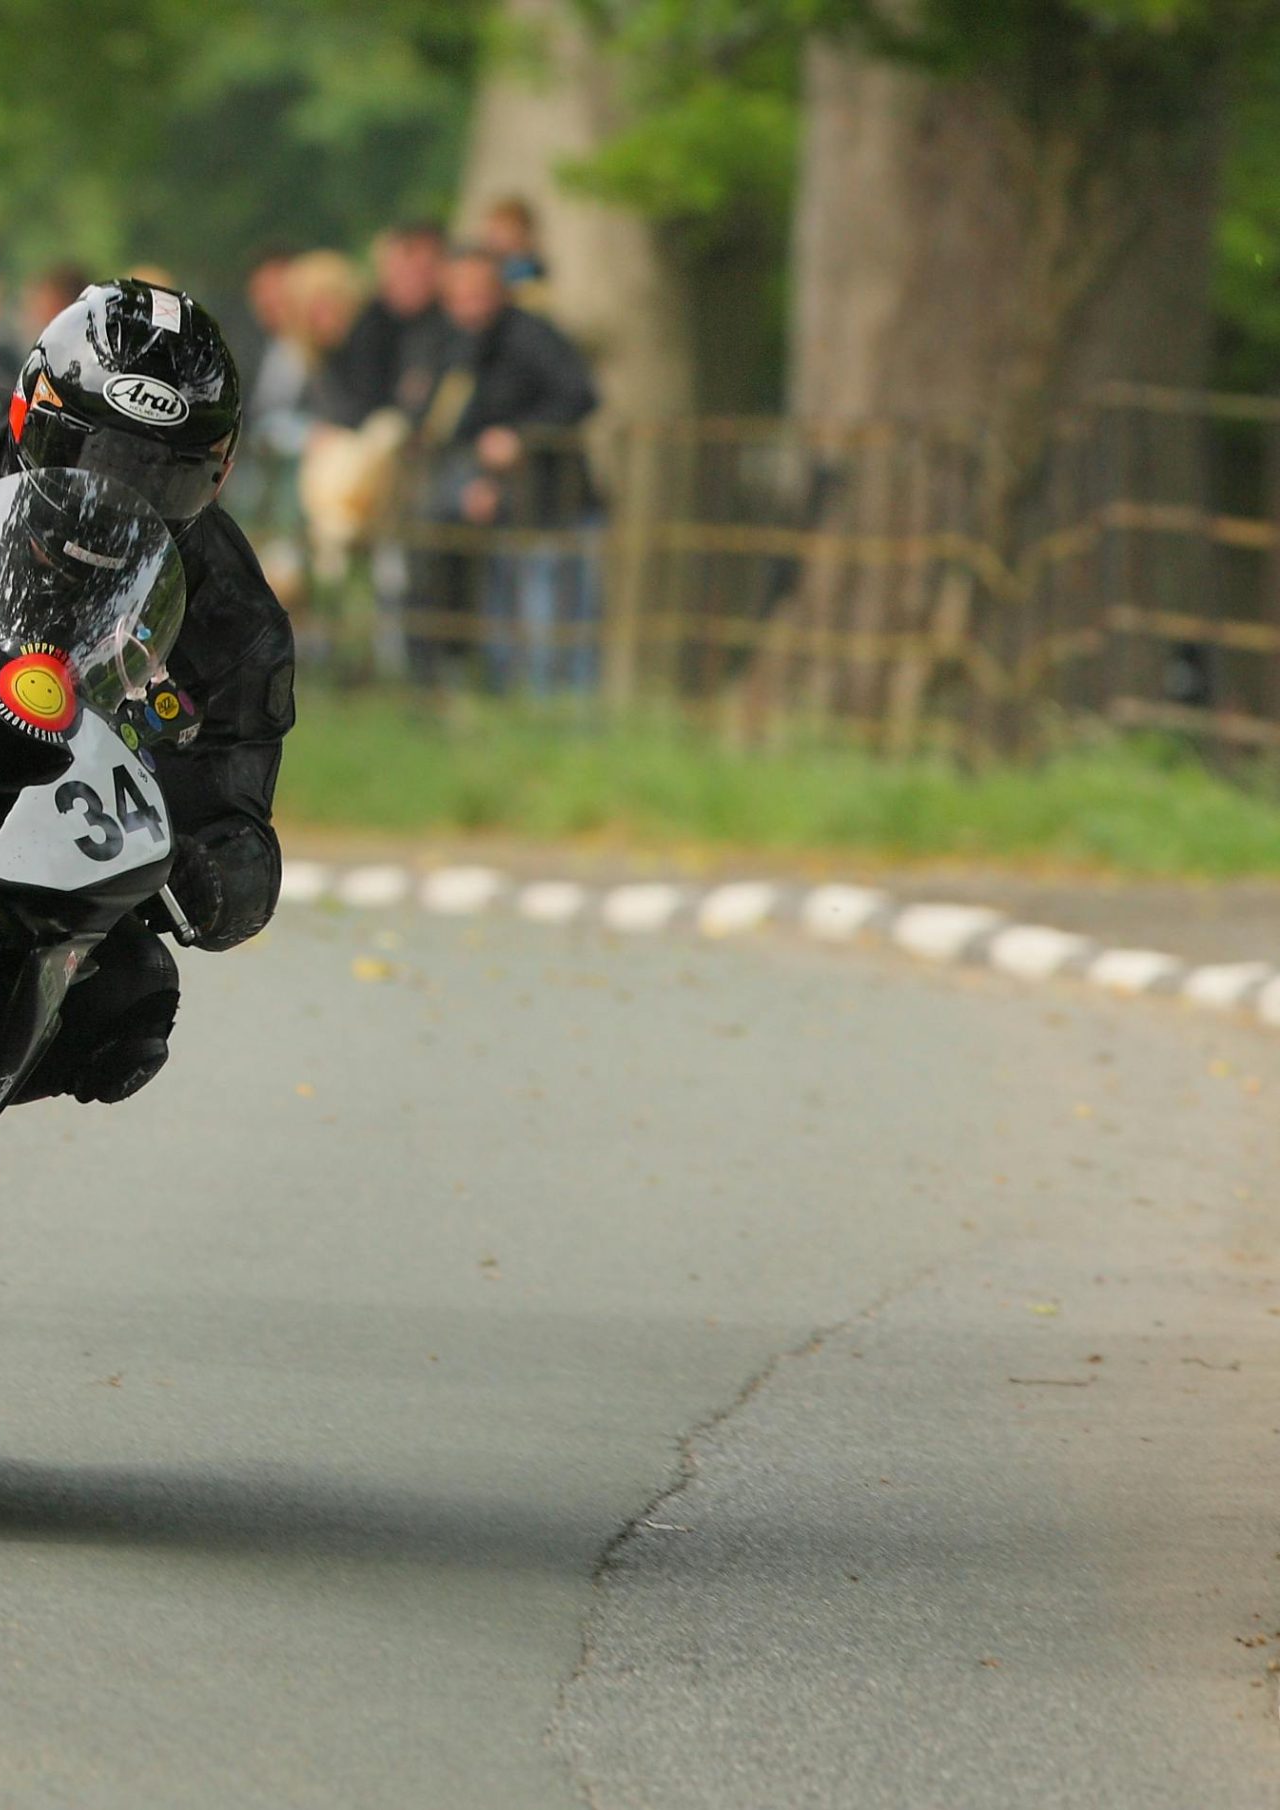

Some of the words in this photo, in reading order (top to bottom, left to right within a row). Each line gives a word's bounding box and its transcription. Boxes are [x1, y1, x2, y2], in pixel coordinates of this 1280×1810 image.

[111, 382, 179, 414] Arai
[20, 642, 55, 655] HAPPY
[54, 764, 165, 862] 34
